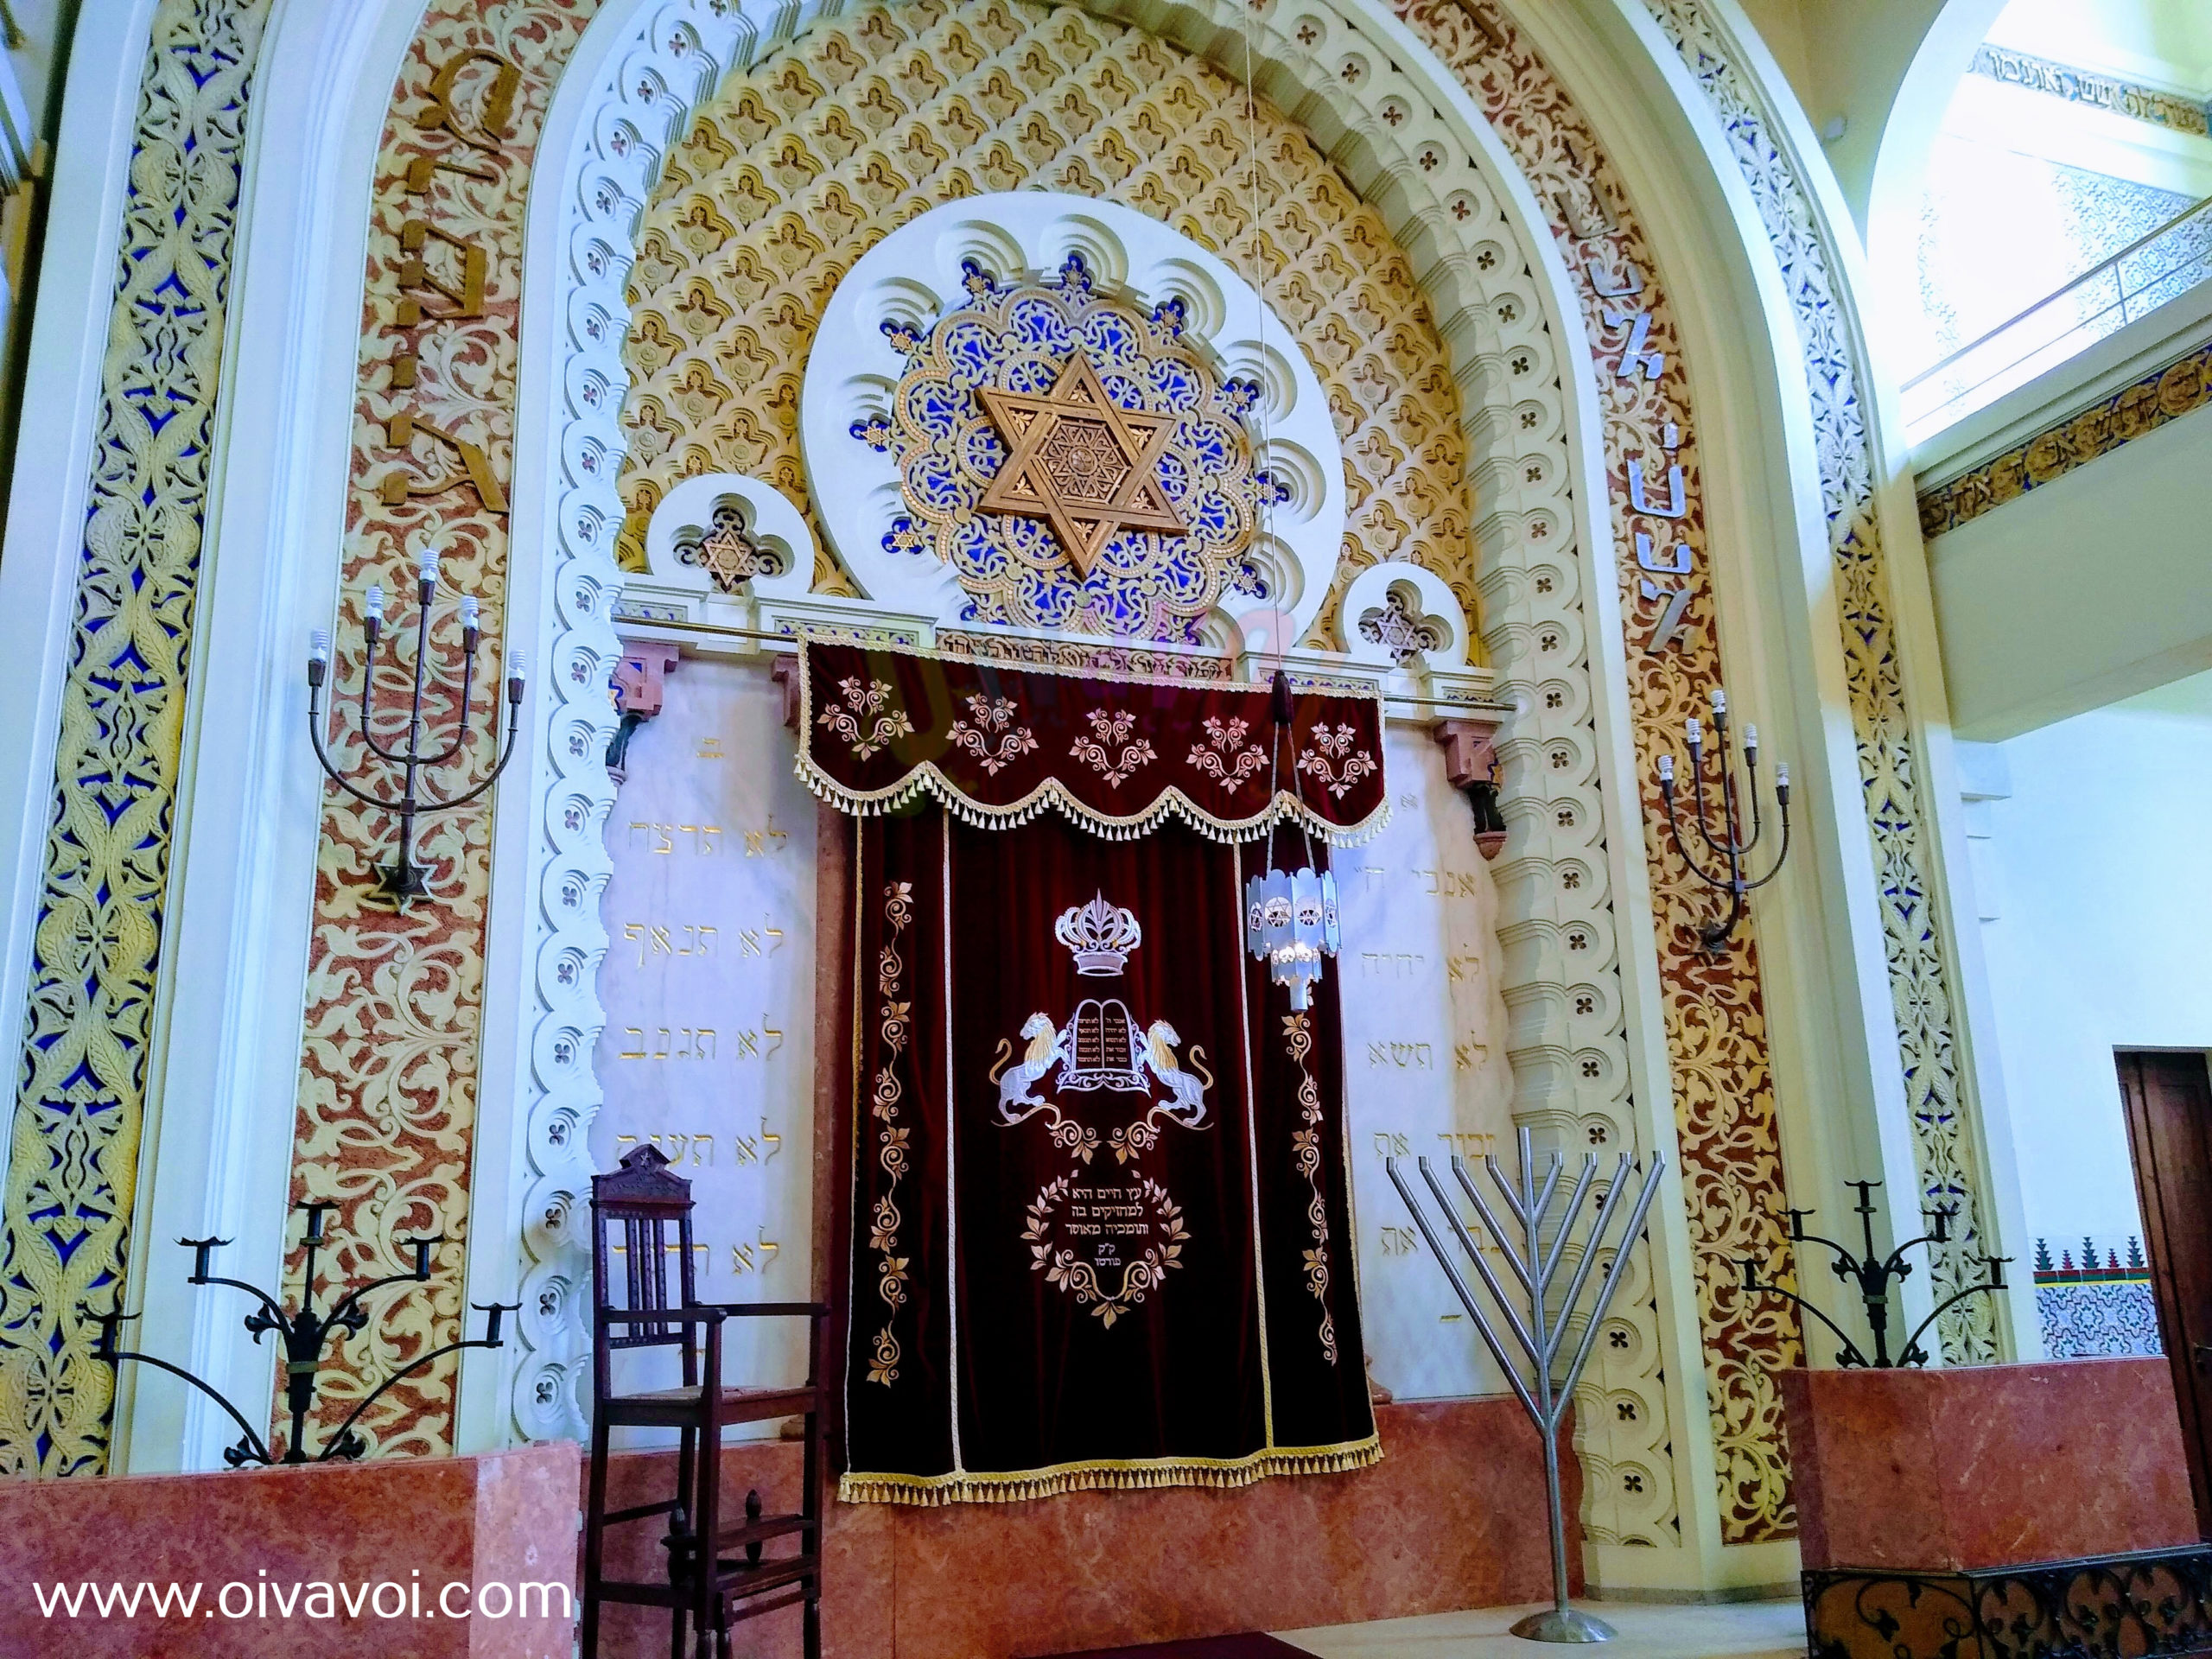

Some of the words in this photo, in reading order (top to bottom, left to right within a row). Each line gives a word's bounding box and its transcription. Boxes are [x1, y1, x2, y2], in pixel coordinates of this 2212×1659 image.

[1626, 423, 1695, 655] אנכי
[629, 822, 723, 857] תרצח
[745, 813, 788, 858] לא
[1411, 868, 1475, 899] אנכי
[624, 923, 719, 969] תנאף
[739, 912, 784, 958] לא
[1362, 953, 1425, 980] יהיה
[1447, 943, 1480, 982] לא
[619, 1027, 716, 1060] תגנב
[738, 1013, 782, 1061] לא
[1455, 1030, 1488, 1071] לא
[1367, 1041, 1433, 1071] תשא
[736, 1116, 781, 1166] לא
[1374, 1132, 1411, 1158] את
[1072, 1188, 1092, 1199] היא
[1096, 1188, 1122, 1199] חיים
[1126, 1187, 1142, 1201] עץ
[1071, 1205, 1087, 1217] בה
[1091, 1202, 1143, 1220] למחזיקים
[733, 1224, 779, 1275] לא
[1381, 1225, 1419, 1256] את
